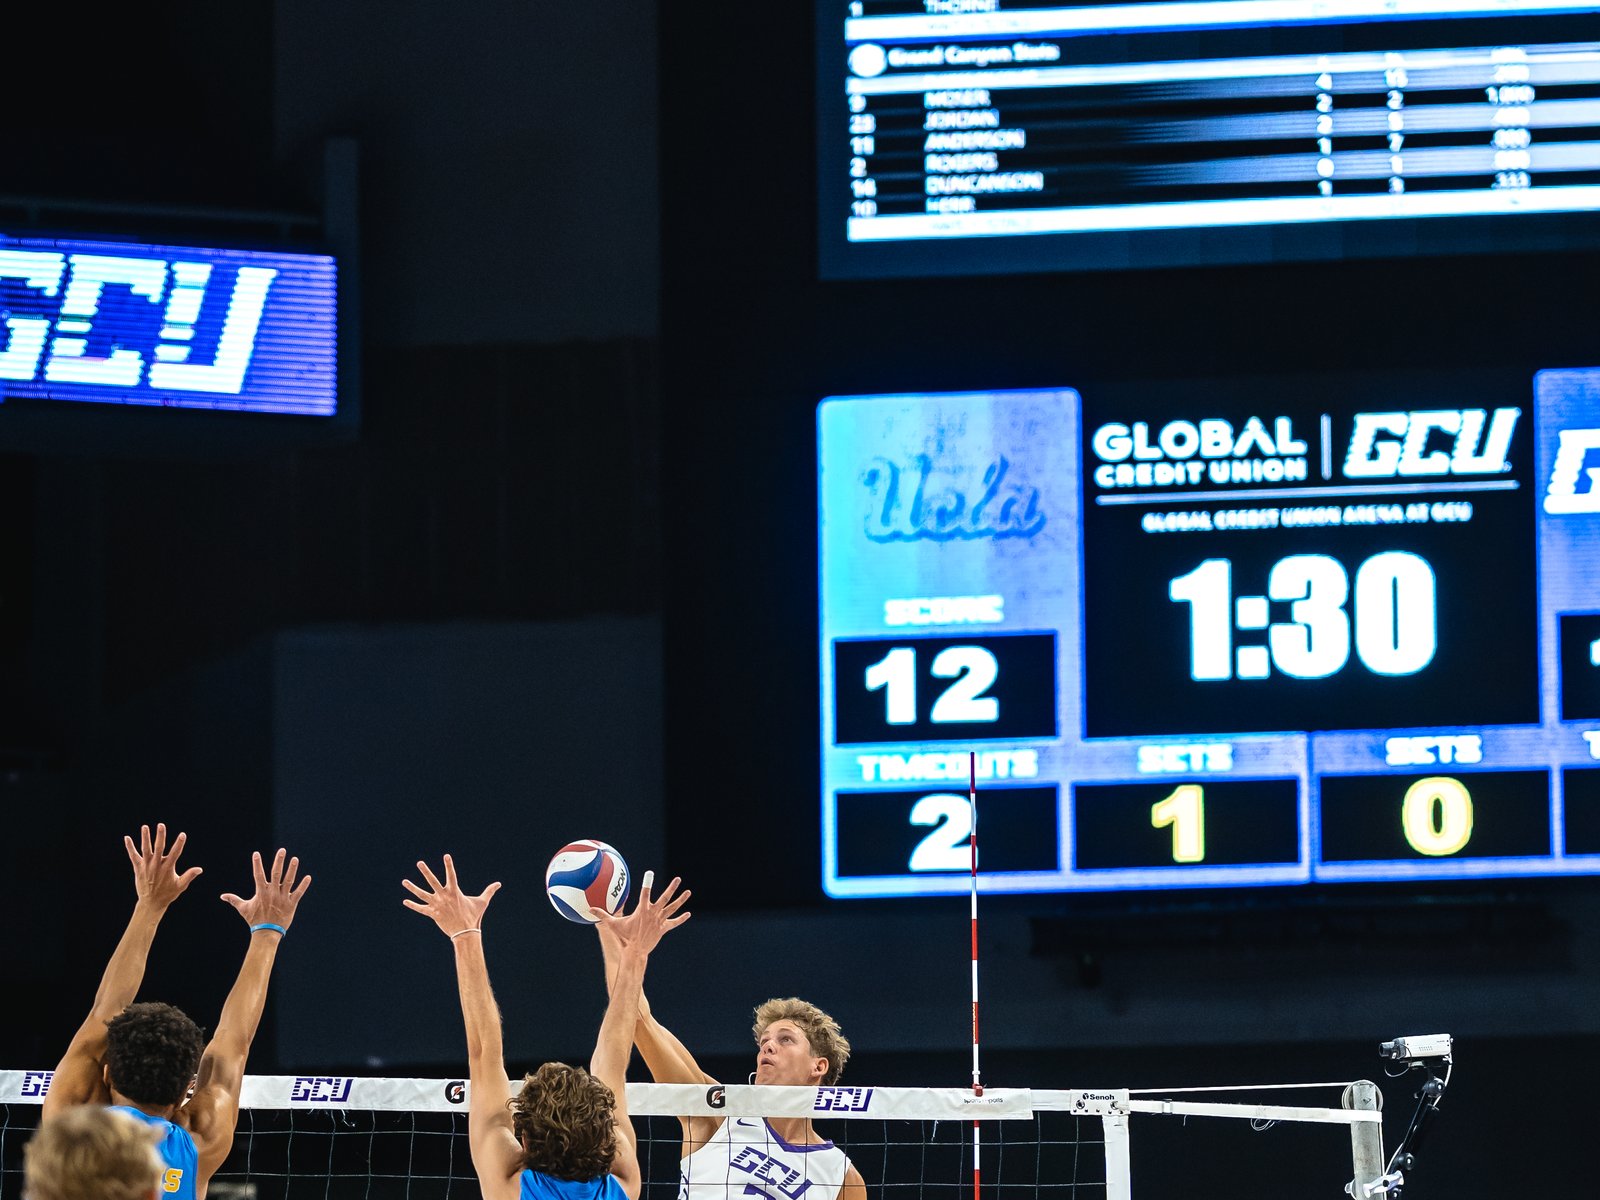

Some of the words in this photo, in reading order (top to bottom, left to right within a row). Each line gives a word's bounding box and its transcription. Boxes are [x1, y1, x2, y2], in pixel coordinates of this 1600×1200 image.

[1316, 93, 1333, 112] 2
[924, 129, 1026, 152] ANDERSON
[1317, 137, 1333, 155] 1
[1092, 415, 1308, 463] GLOBAL
[1343, 406, 1521, 478] GCU
[1093, 461, 1206, 488] CREDIT
[1208, 457, 1308, 484] UNION
[1141, 511, 1214, 533] GLOBAL
[1213, 508, 1279, 530] CREDIT
[1280, 506, 1342, 528] UNION
[884, 596, 1005, 626] SCORE
[1169, 552, 1438, 681] 1:30
[865, 645, 1000, 725] 12
[1137, 743, 1233, 773] SETS
[1385, 735, 1482, 765] SETS
[857, 749, 1038, 782] TIMEOUTS
[1151, 785, 1205, 863] 1
[1402, 777, 1473, 856] 0
[909, 794, 978, 872] 2
[290, 1077, 354, 1102] GCU
[813, 1087, 874, 1112] GCU
[1089, 1093, 1115, 1101] Senoh
[729, 1145, 814, 1200] GCU
